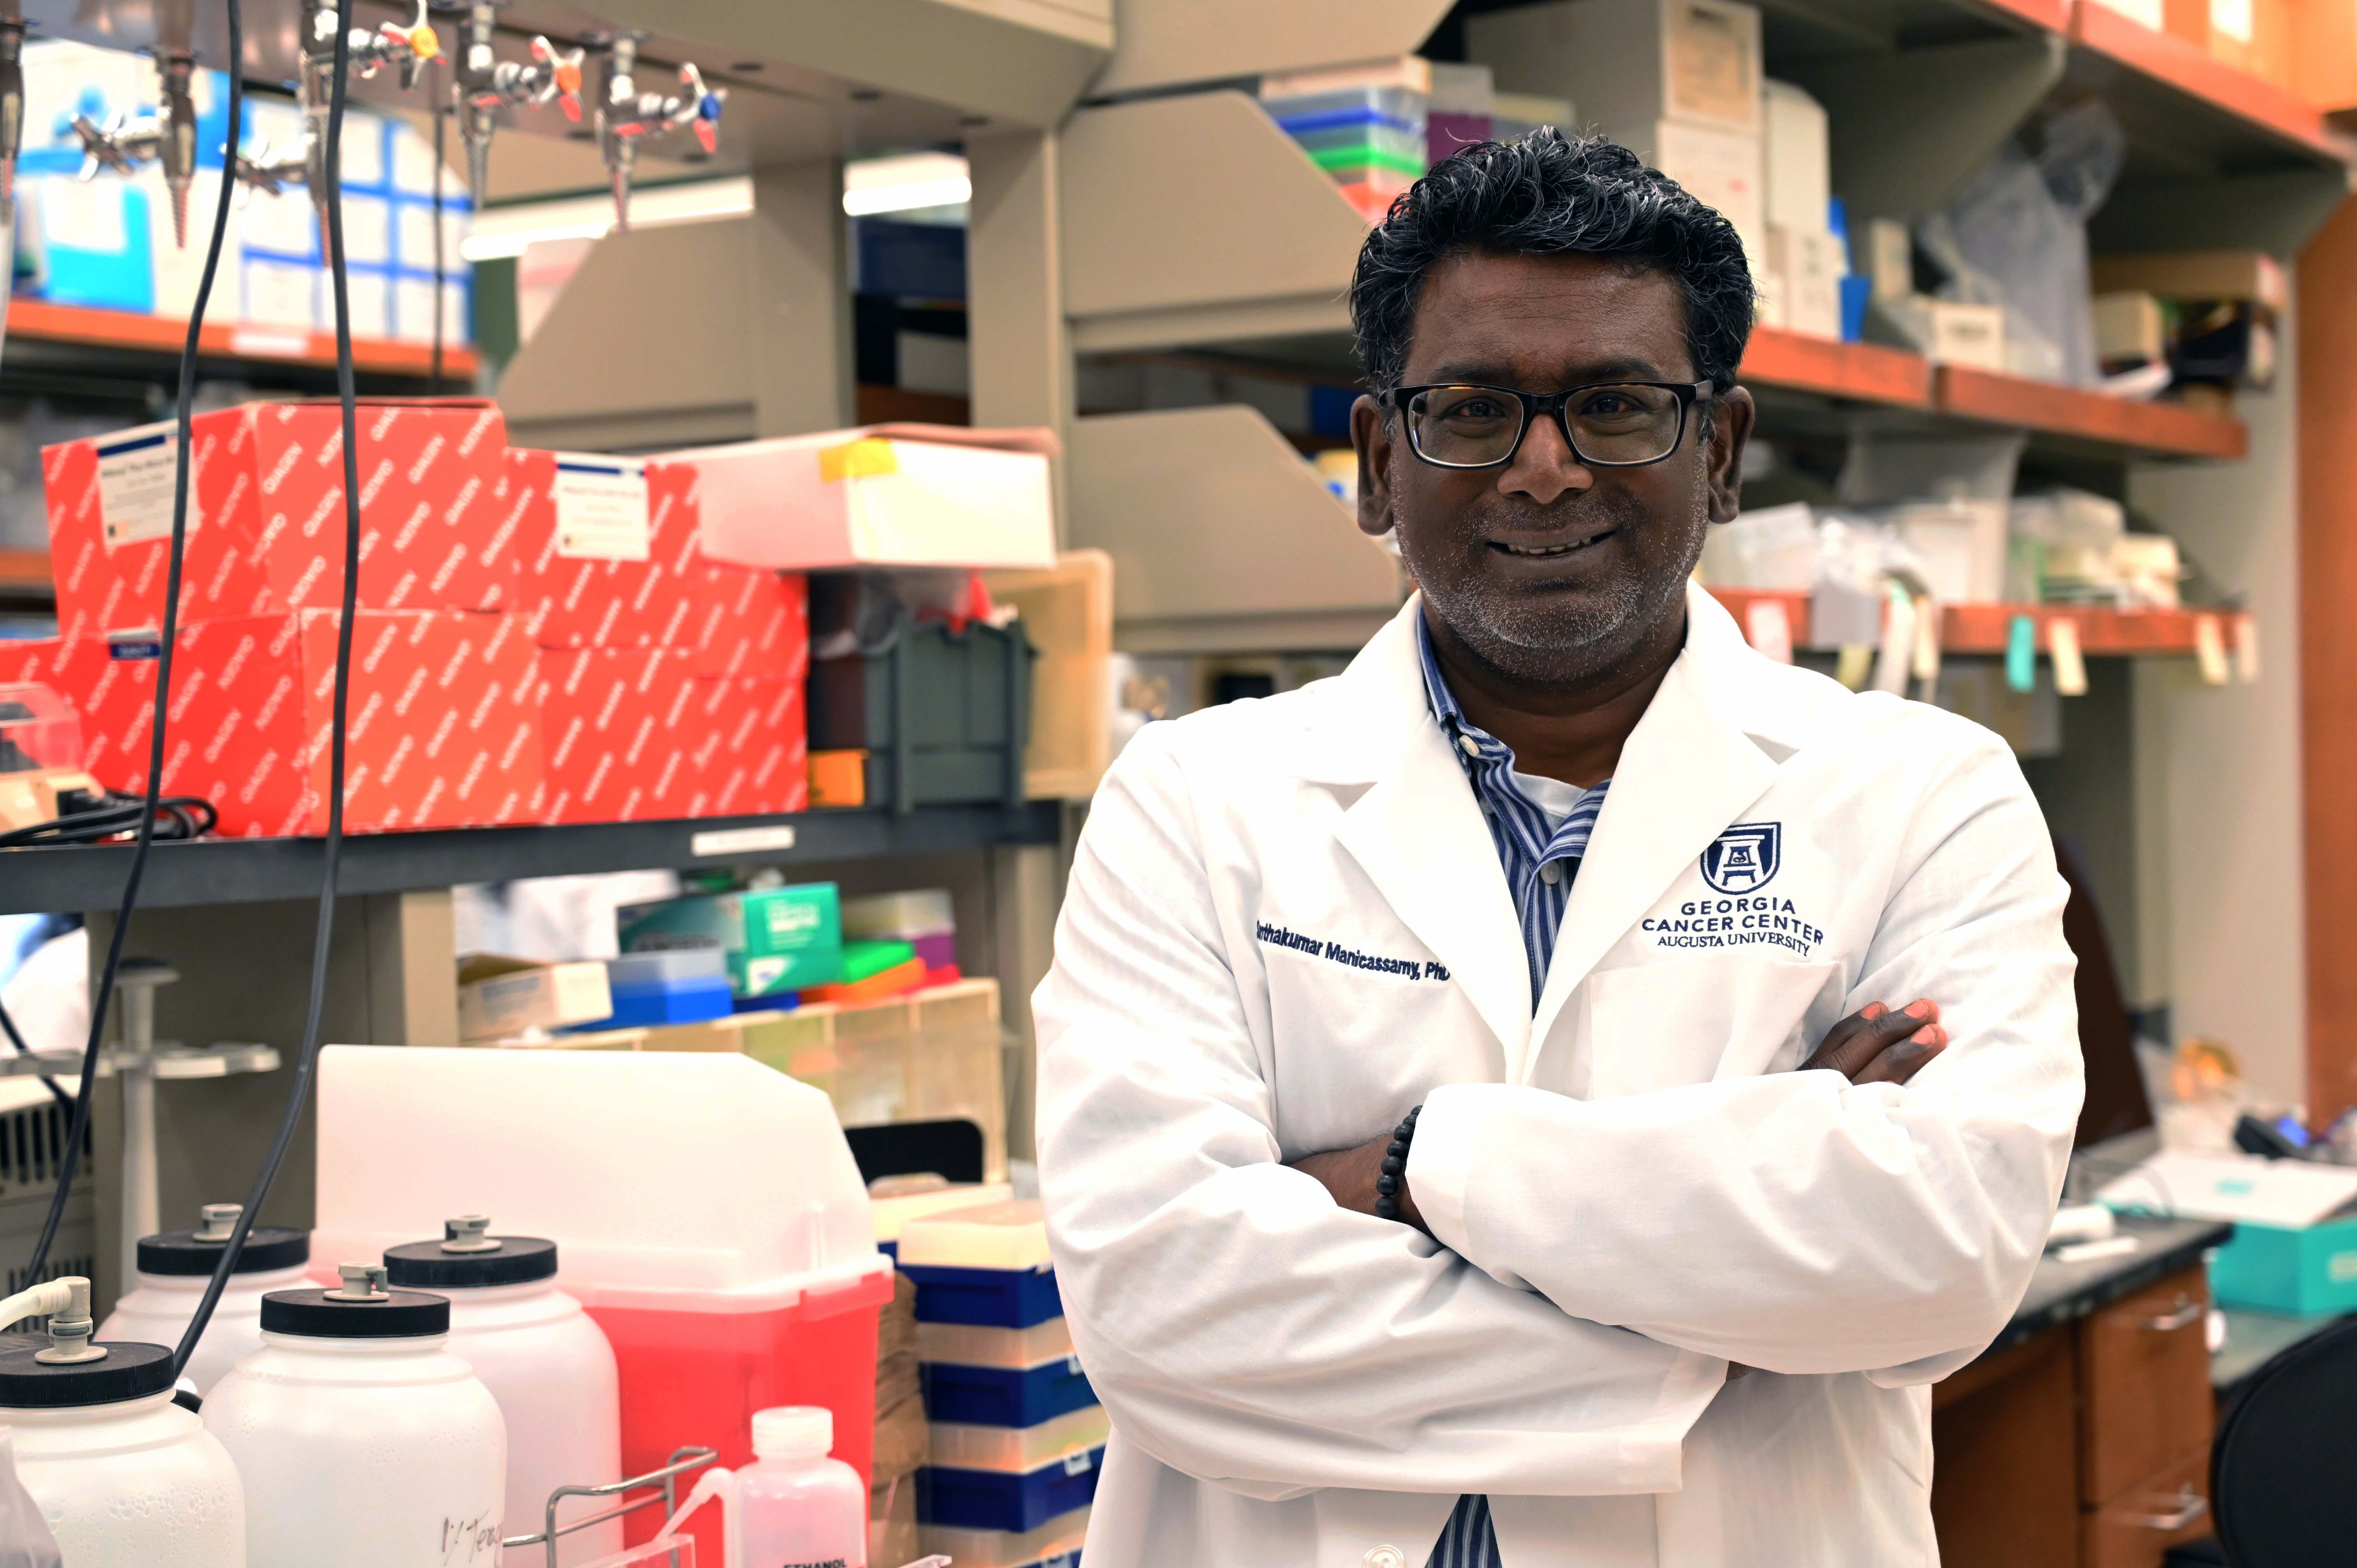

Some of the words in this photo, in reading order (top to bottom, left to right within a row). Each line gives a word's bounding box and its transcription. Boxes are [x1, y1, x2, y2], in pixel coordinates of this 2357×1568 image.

[1681, 897, 1795, 915] GEORGIA
[1642, 917, 1733, 932] CANCER
[1742, 915, 1823, 945] CENTER
[1658, 936, 1724, 948] AUGUSTA
[1728, 932, 1810, 957] UNIVERSITY
[1325, 942, 1420, 980] Manicassamy,
